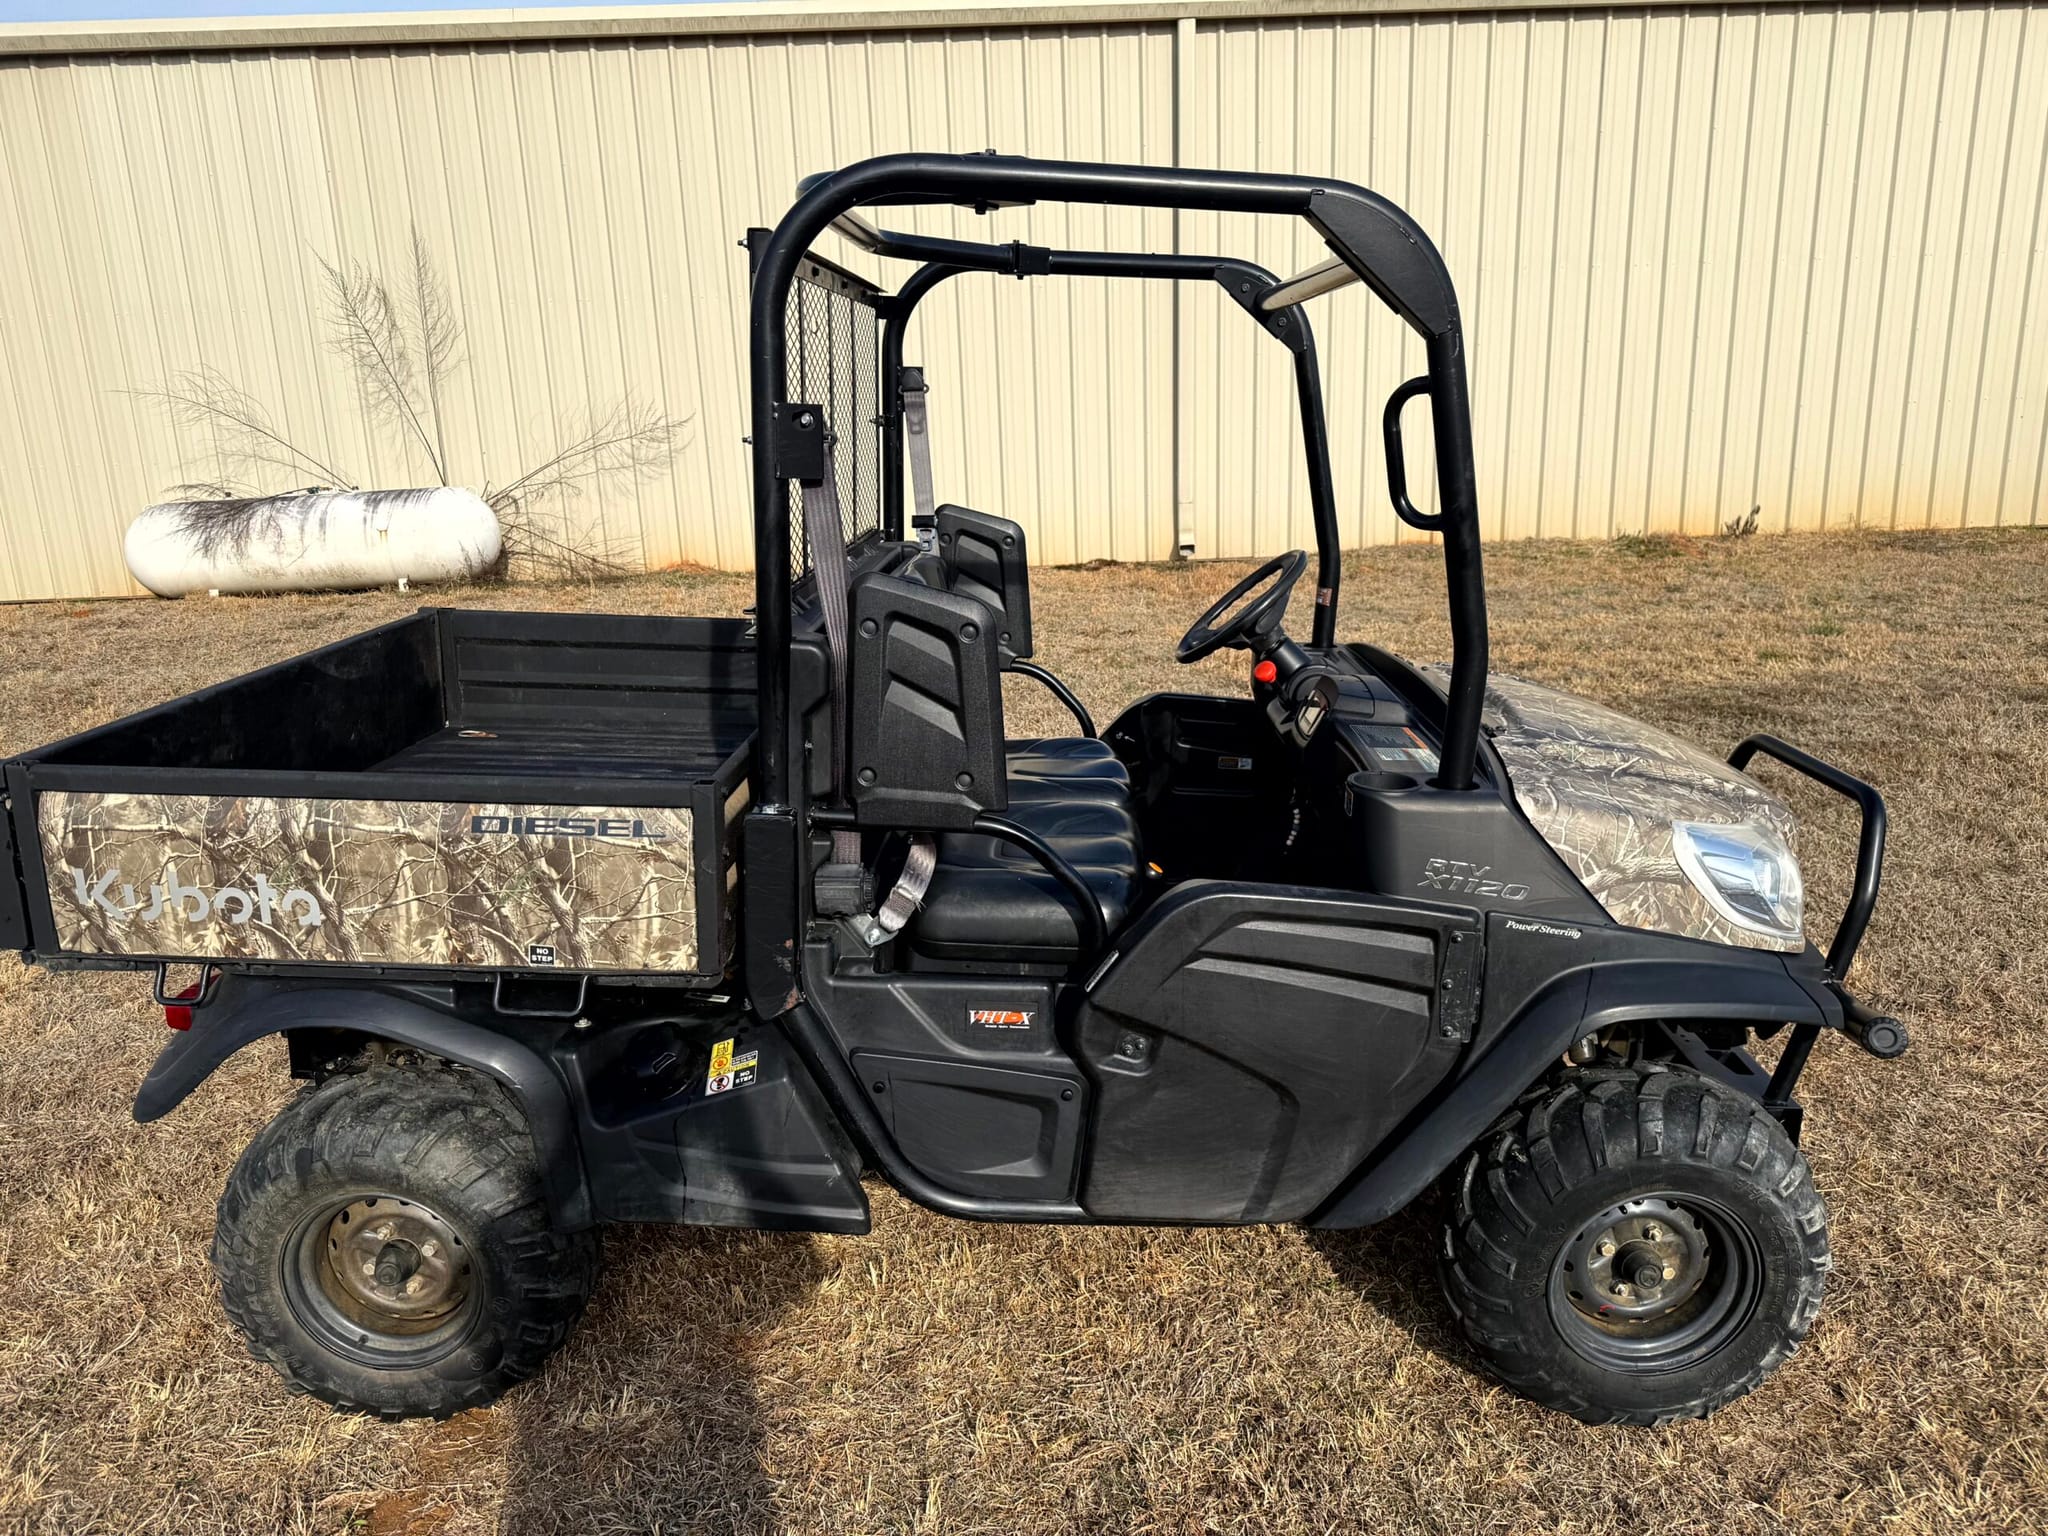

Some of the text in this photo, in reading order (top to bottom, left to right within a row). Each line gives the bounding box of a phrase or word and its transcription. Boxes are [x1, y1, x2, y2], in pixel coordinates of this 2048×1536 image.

[471, 815, 666, 839] DIESEL
[1425, 858, 1491, 877] RTV
[1417, 872, 1530, 900] X1120
[74, 868, 322, 927] Kubota
[1505, 920, 1582, 940] Power Steering
[531, 954, 553, 962] STEP
[536, 947, 549, 955] NO
[735, 1074, 753, 1084] STEP
